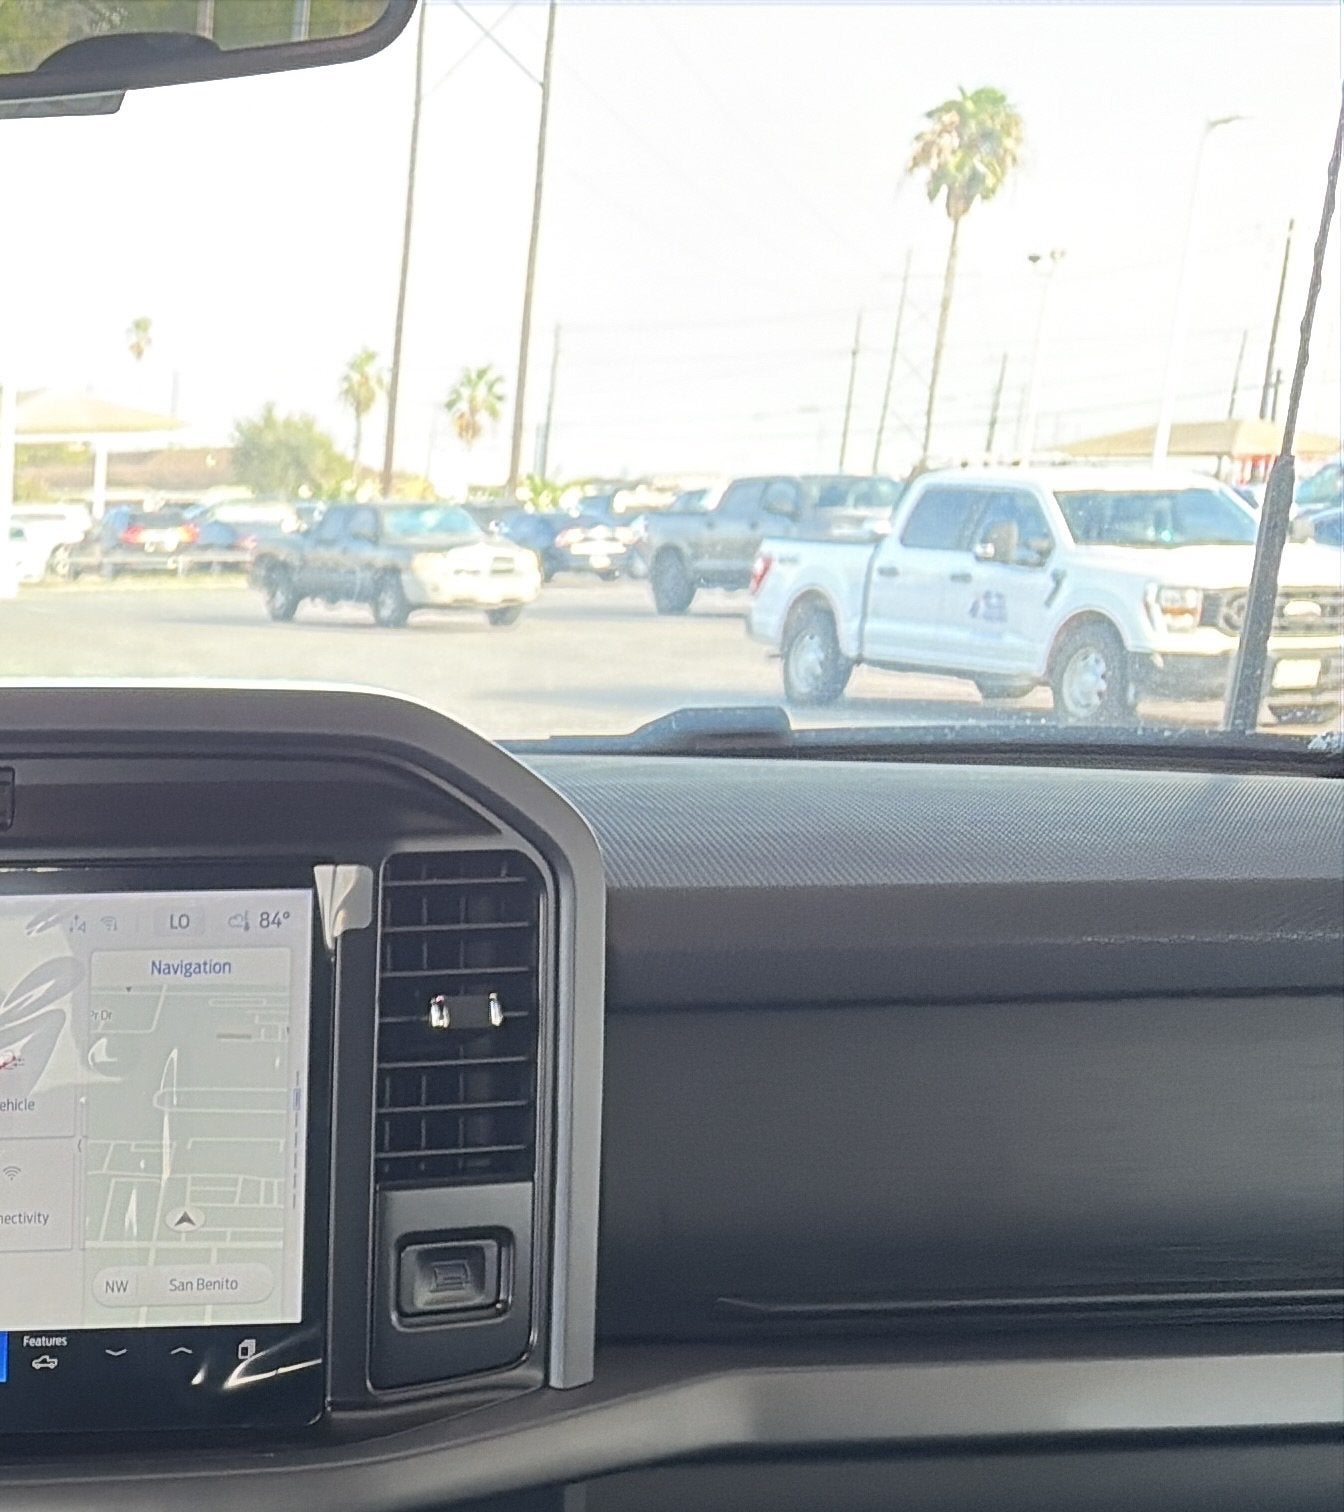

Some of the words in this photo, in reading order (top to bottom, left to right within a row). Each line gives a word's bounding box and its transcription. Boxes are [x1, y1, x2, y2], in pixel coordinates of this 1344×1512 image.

[169, 914, 191, 930] LO
[150, 960, 232, 978] Navigation
[105, 1279, 129, 1294] NW
[169, 1278, 193, 1292] San
[196, 1277, 239, 1291] Benito
[23, 1335, 68, 1347] Features
